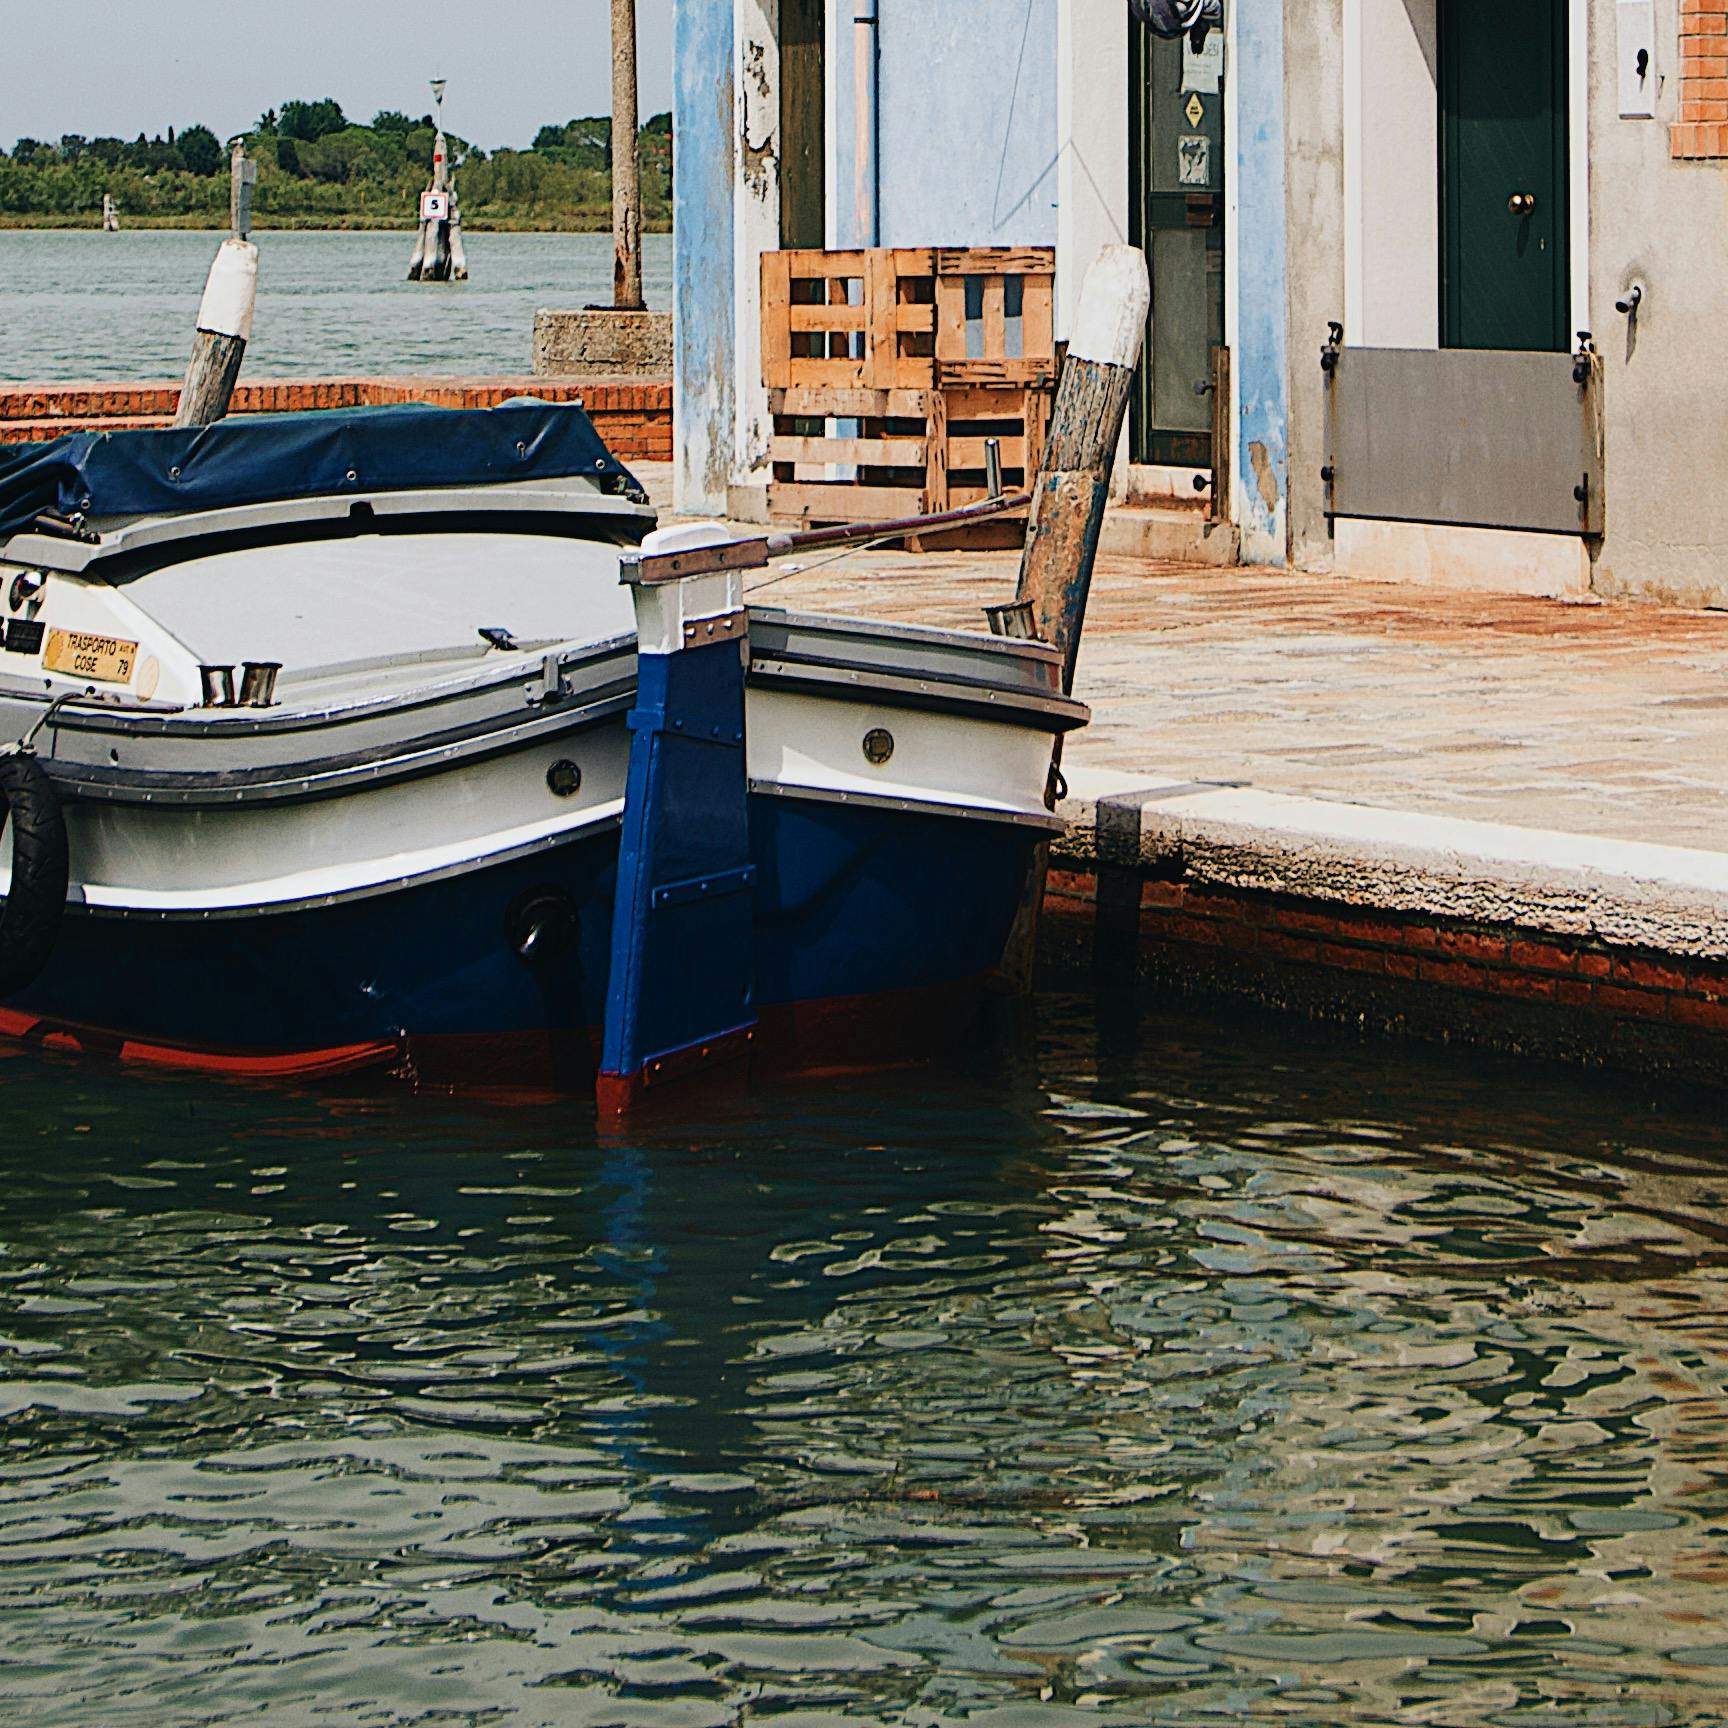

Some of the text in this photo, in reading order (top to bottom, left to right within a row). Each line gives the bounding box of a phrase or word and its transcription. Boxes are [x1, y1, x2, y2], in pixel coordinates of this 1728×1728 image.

[431, 199, 439, 210] 5
[67, 633, 117, 656] TRASPORTO
[74, 654, 129, 676] COSE 79
